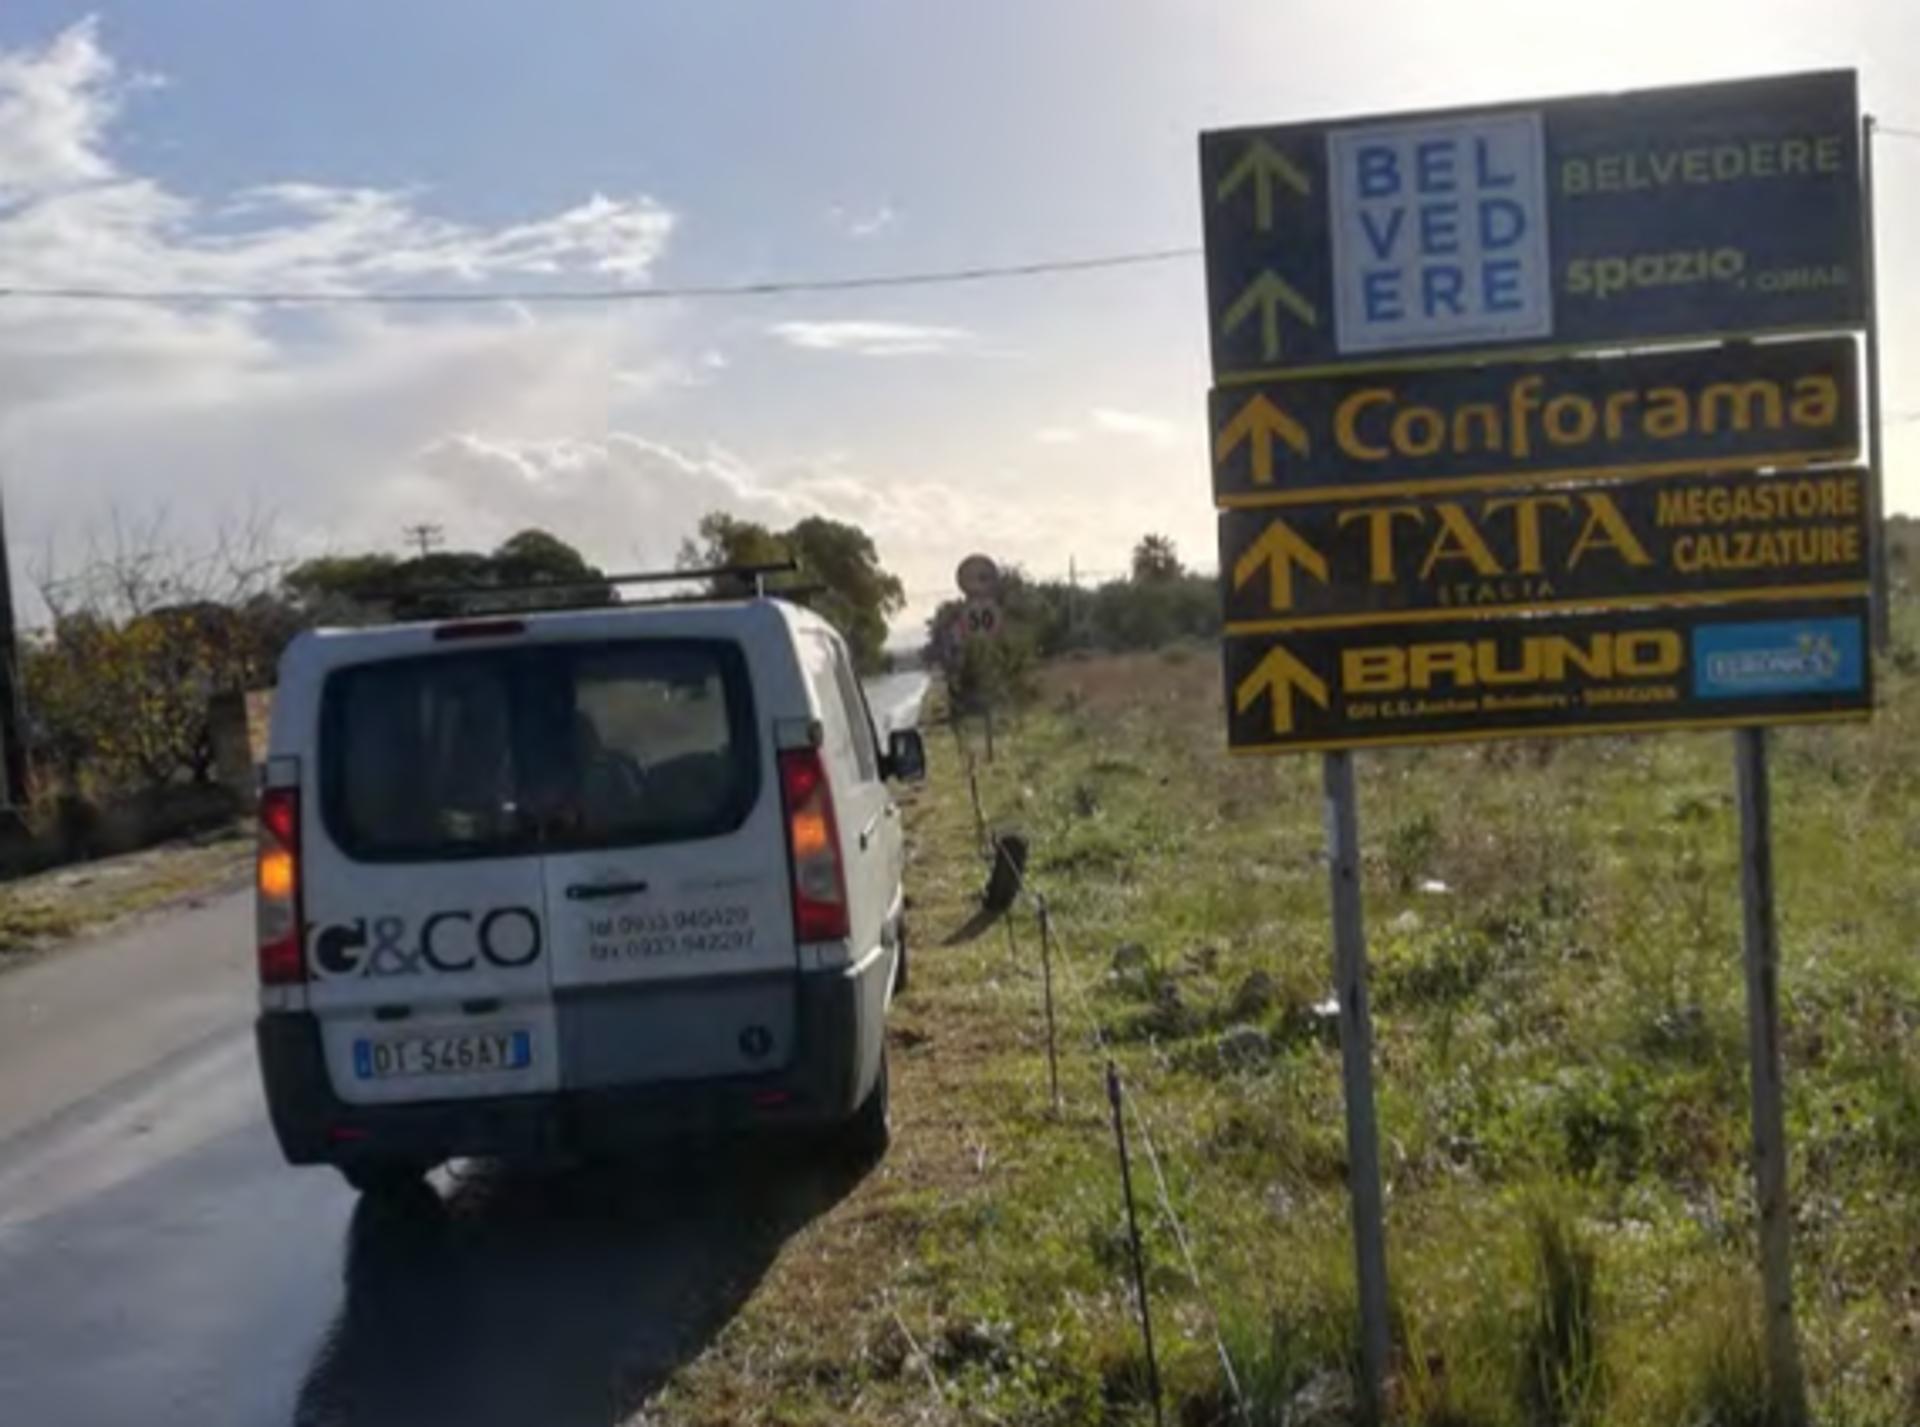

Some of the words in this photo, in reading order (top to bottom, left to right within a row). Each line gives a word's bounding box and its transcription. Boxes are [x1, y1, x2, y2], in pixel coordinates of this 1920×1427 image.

[1356, 136, 1516, 197] BEL
[1562, 136, 1842, 196] BELVEDERE
[1360, 199, 1526, 260] VED
[1362, 260, 1523, 322] ERE
[1333, 374, 1840, 460] Conforama
[1657, 477, 1860, 527] MEGASTORE
[1336, 494, 1652, 583] TATA
[1672, 525, 1860, 572] CALZATURE
[1438, 580, 1555, 605] ITALIA
[1341, 629, 1683, 693] BRUNO
